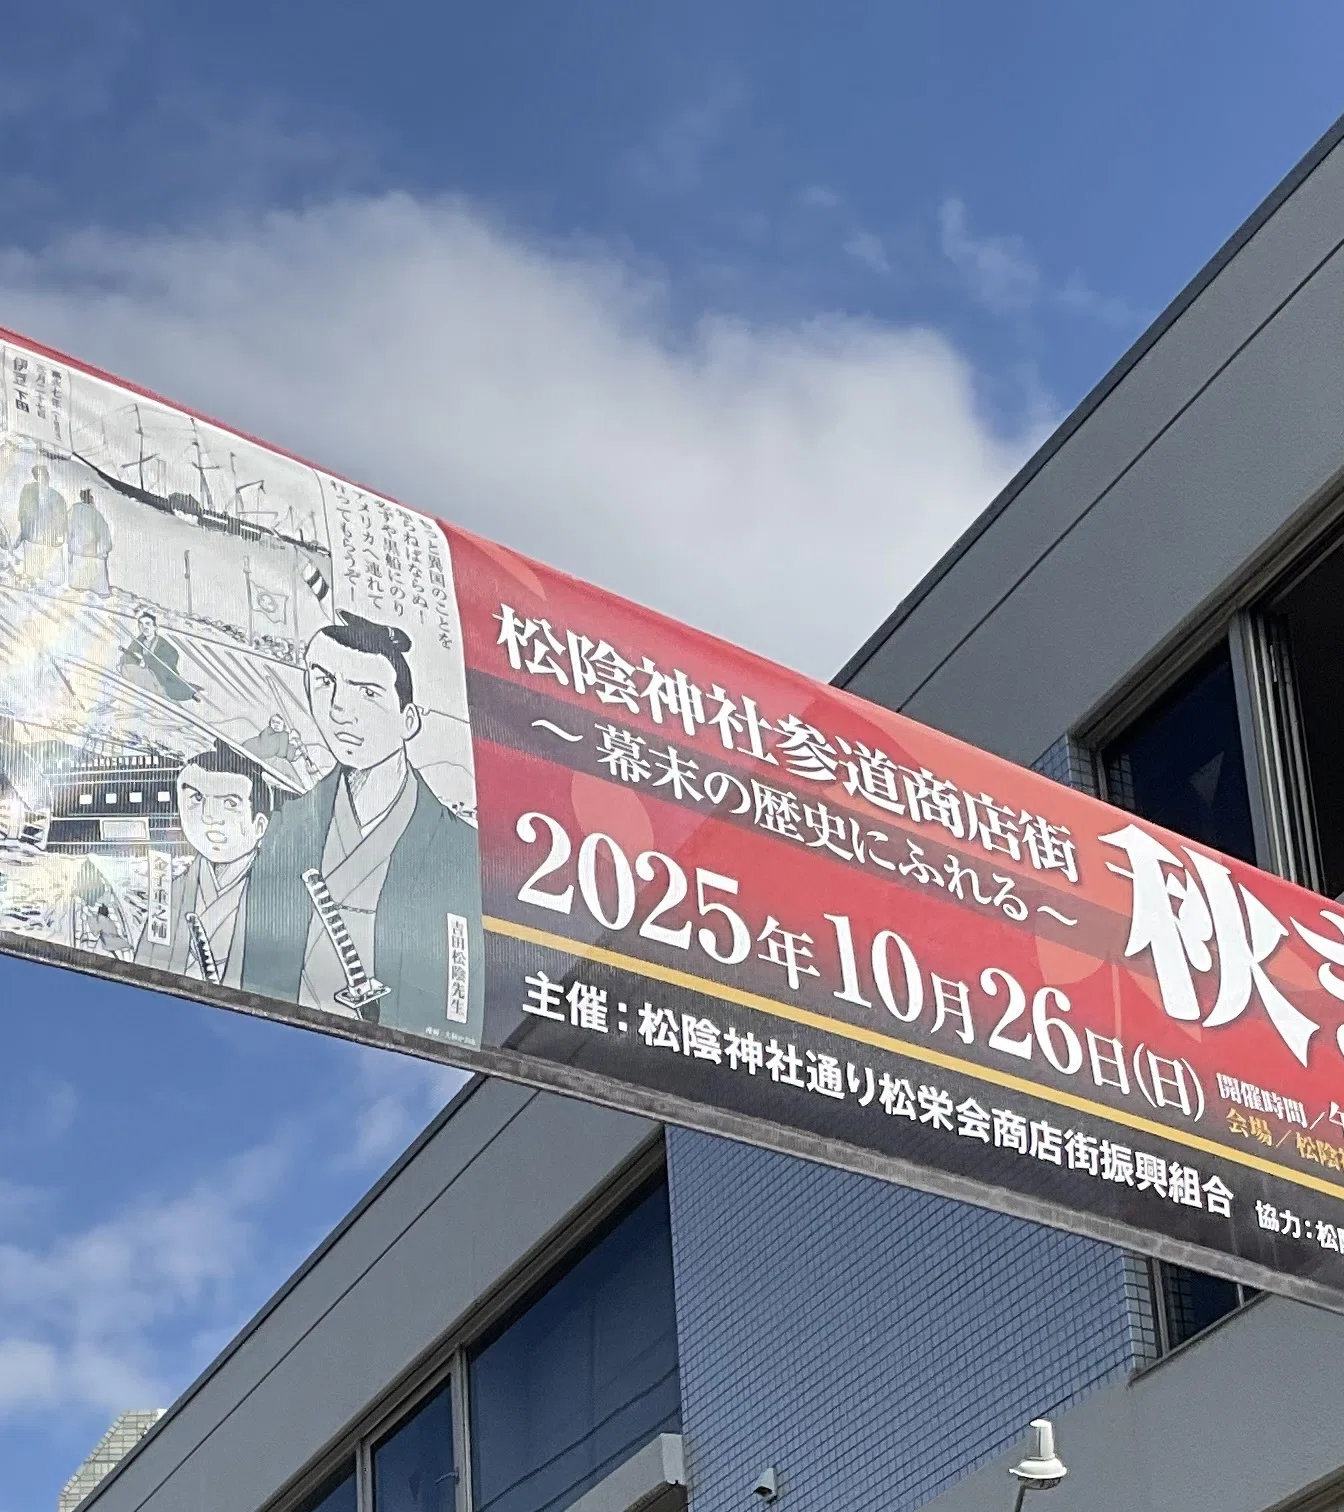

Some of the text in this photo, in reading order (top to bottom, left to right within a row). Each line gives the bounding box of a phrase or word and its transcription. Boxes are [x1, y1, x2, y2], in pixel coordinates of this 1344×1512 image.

[492, 603, 1080, 884] 松陰神社参道商店街
[450, 920, 467, 1016] 吉田松陰先生
[516, 811, 1205, 1123] 2025年10月26日(日)
